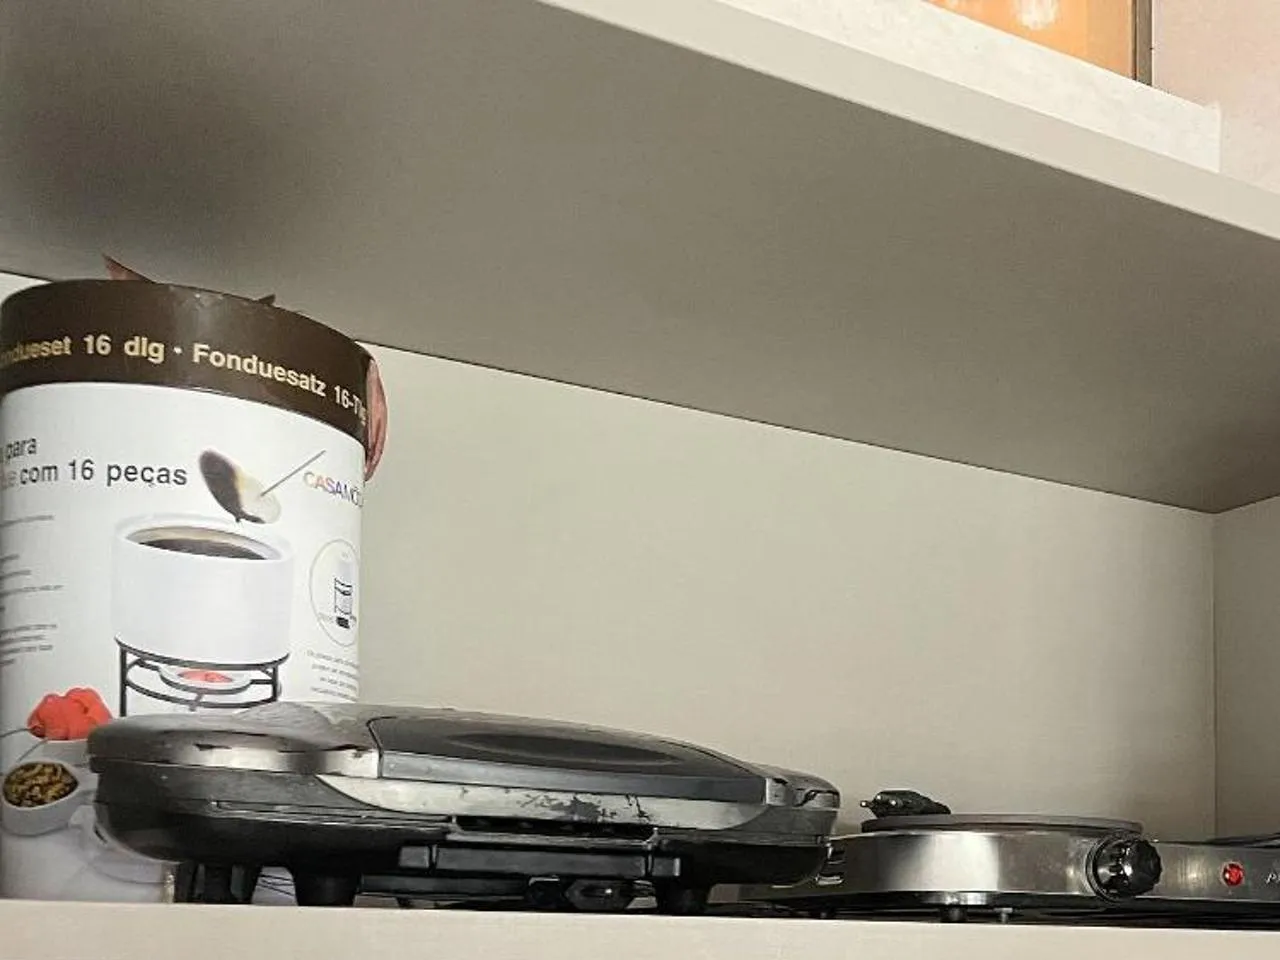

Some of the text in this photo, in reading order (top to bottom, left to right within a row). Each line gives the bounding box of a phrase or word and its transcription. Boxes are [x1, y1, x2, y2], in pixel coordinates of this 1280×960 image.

[83, 334, 112, 355] 16
[192, 342, 327, 397] Fonduesatz
[20, 465, 58, 485] com
[68, 459, 95, 481] 16
[106, 464, 188, 488] peças
